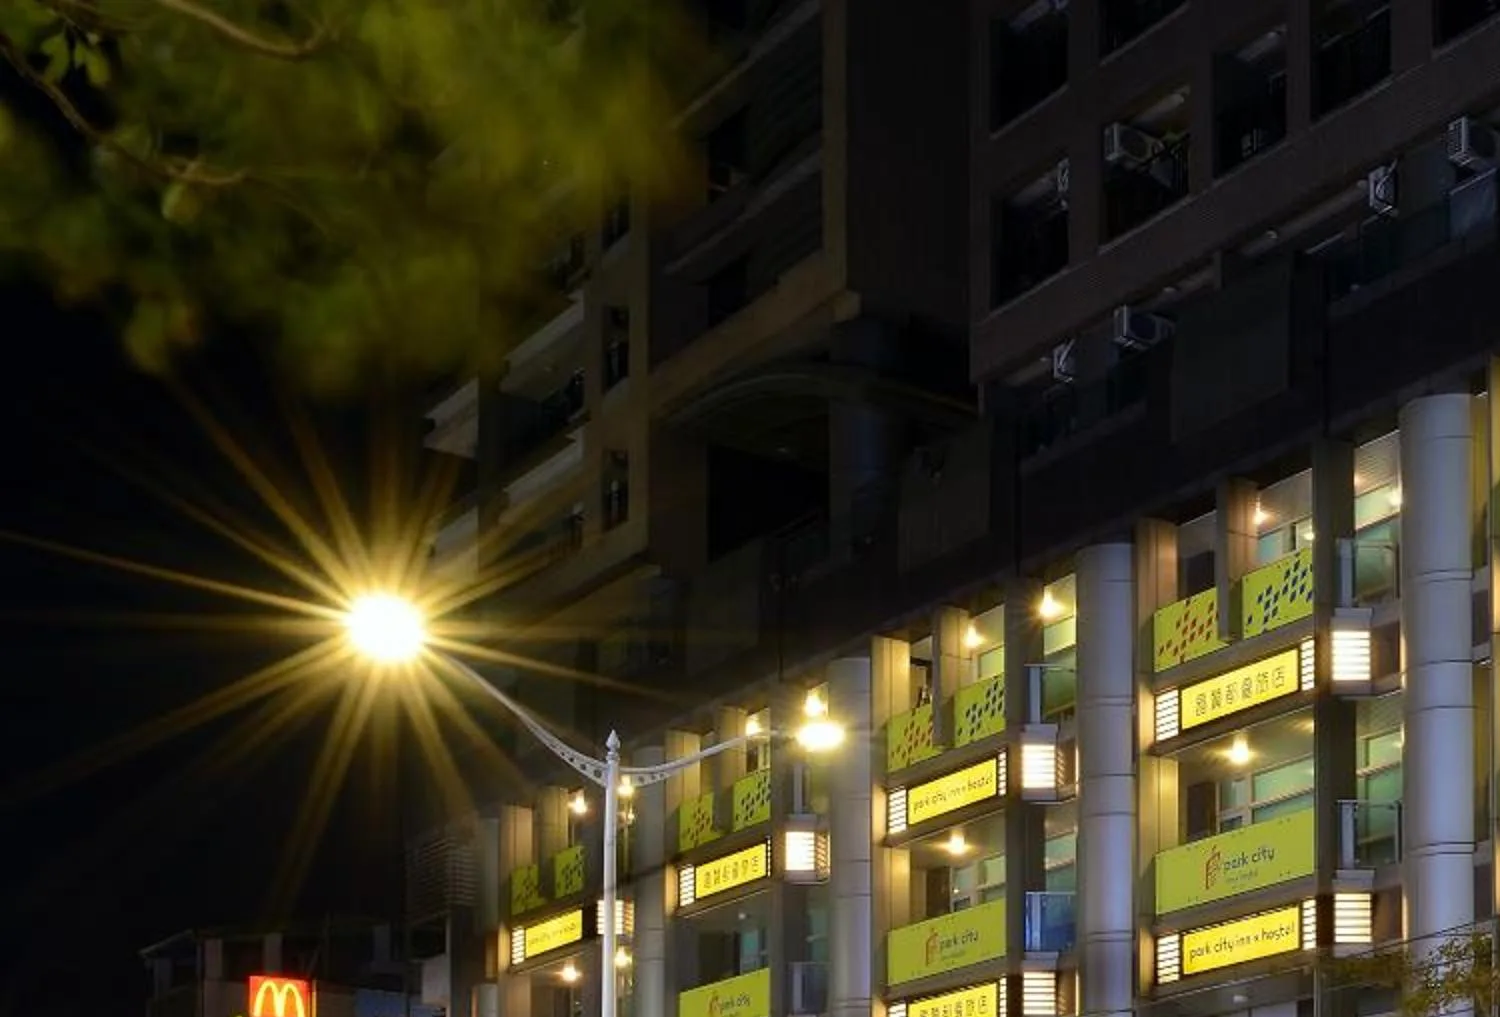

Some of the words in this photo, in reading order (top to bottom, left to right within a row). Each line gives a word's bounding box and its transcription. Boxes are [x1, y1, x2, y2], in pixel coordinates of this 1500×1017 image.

[1224, 852, 1249, 872] park
[1251, 847, 1275, 863] city
[1190, 942, 1211, 965] park
[1213, 937, 1234, 953] city
[1261, 921, 1296, 941] hostel
